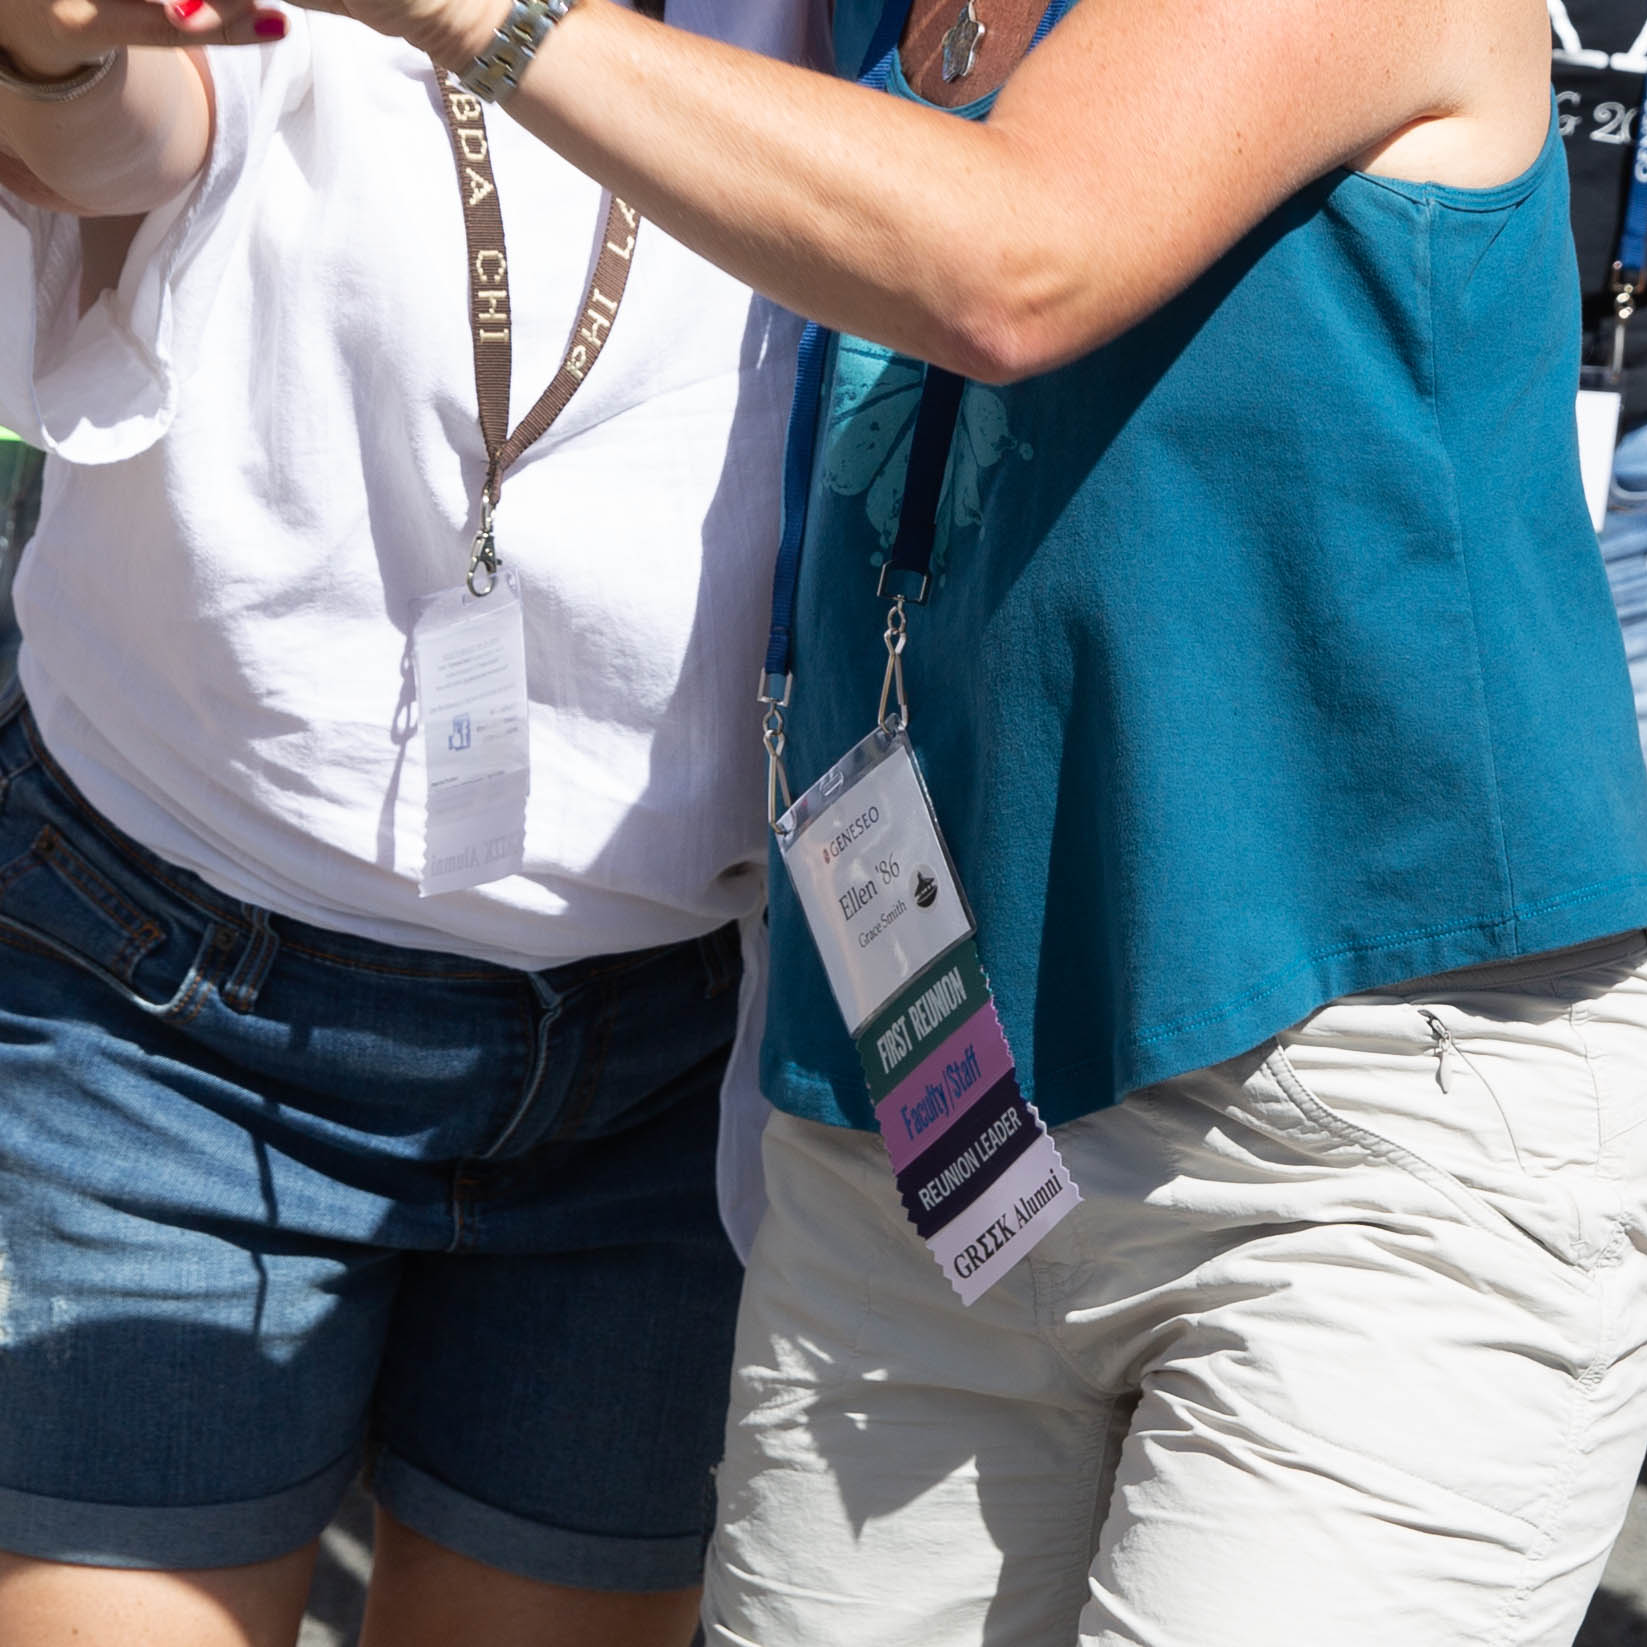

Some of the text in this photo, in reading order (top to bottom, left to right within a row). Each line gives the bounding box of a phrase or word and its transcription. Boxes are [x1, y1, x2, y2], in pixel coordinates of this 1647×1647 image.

[449, 93, 509, 343] BDA CHI
[566, 288, 618, 381] PHI
[830, 806, 879, 857] GENESEO
[838, 852, 900, 921] Ellen '86
[859, 900, 908, 948] Grace Smith
[876, 966, 967, 1074] FIRST REUNION
[900, 1044, 982, 1141] Faculty/Staff
[918, 1106, 1022, 1212] REUNION LEADER
[1014, 1168, 1063, 1230] Alumni
